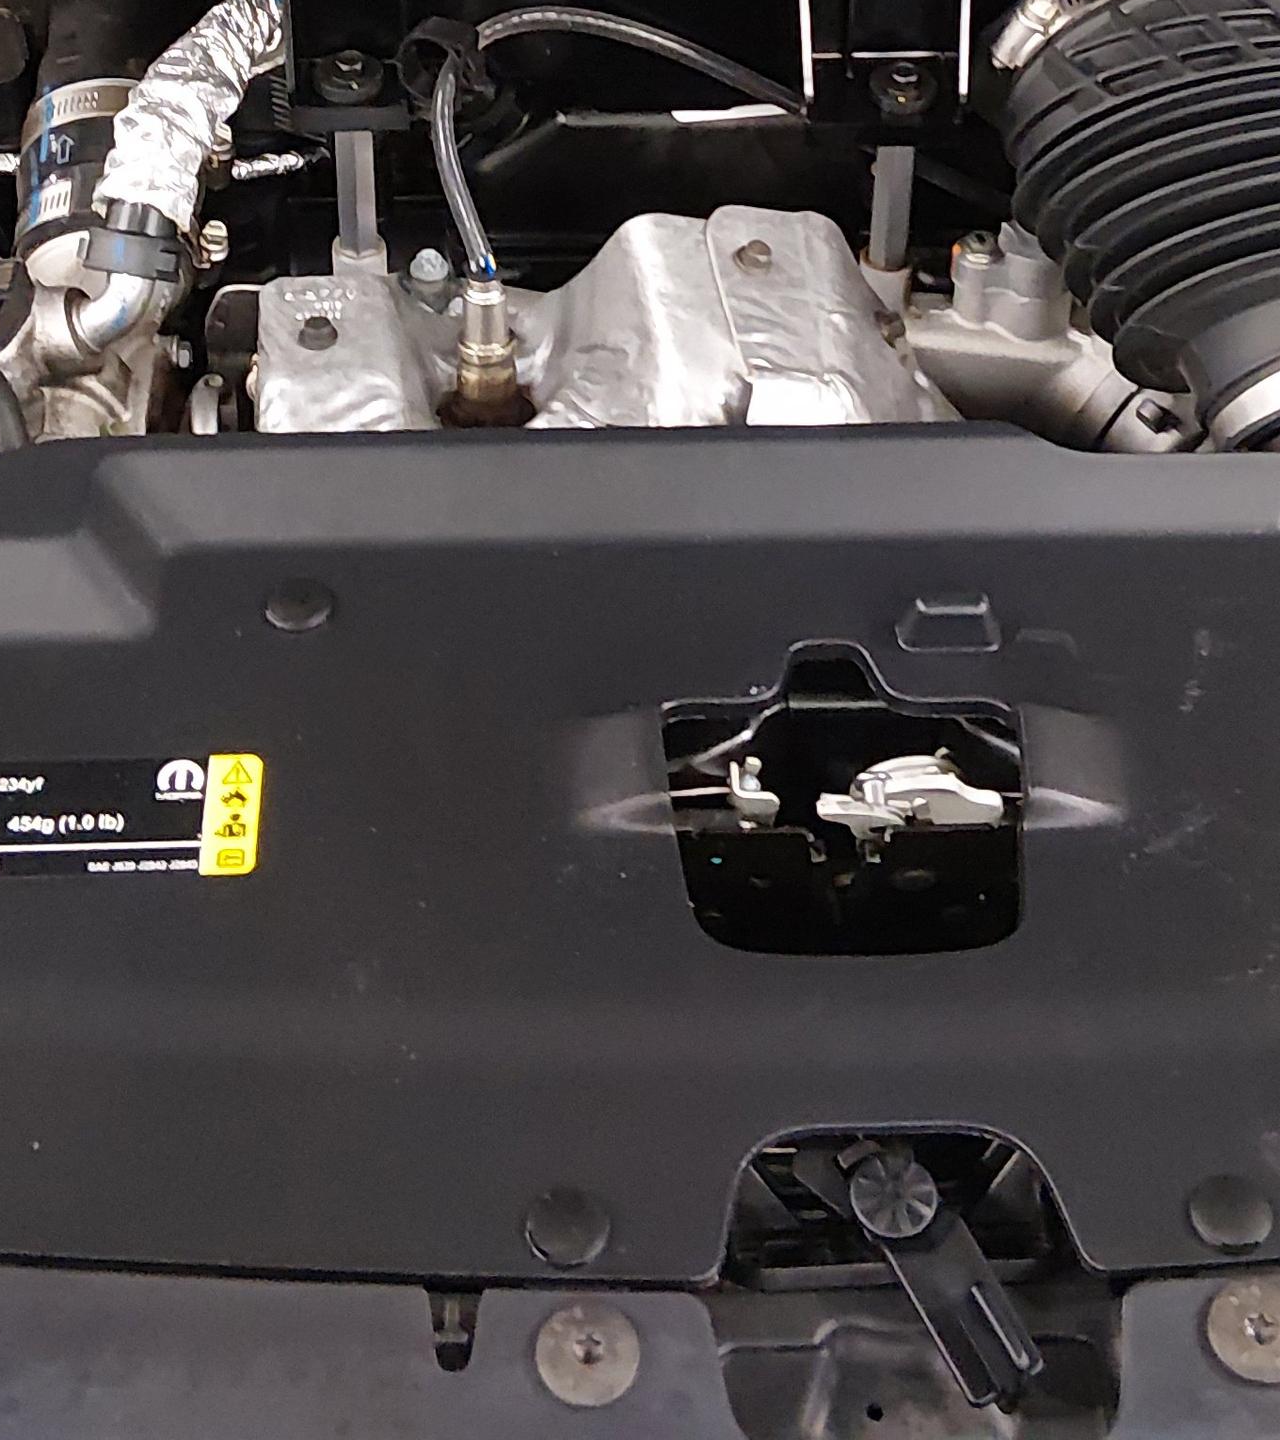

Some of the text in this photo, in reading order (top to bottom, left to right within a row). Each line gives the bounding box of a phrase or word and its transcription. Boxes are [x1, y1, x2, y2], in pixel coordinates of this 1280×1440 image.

[7, 813, 125, 835] 454g (1.0 lb)
